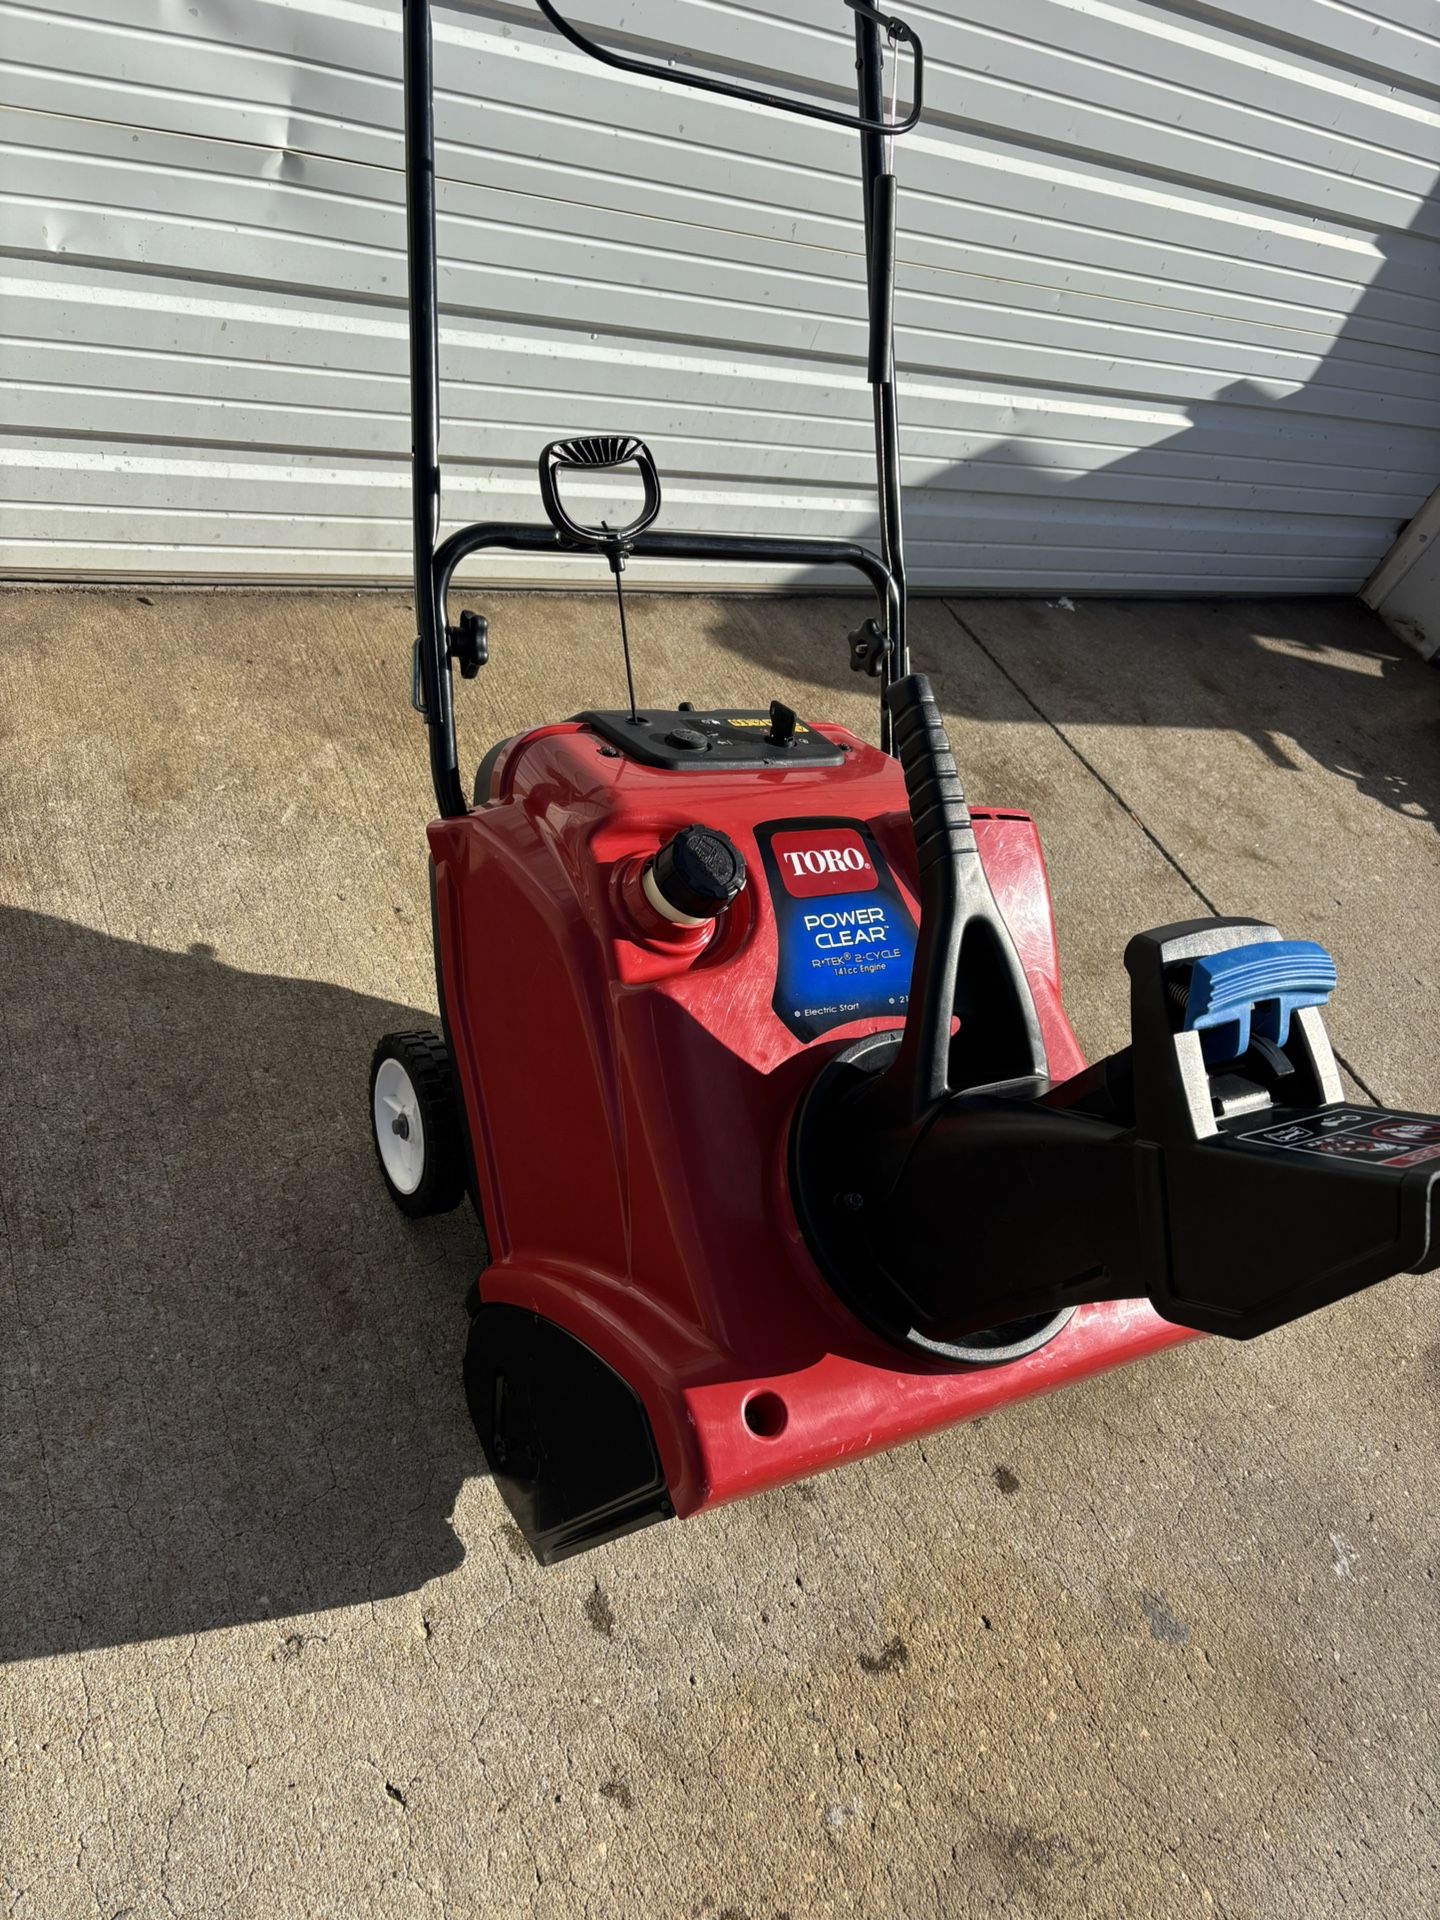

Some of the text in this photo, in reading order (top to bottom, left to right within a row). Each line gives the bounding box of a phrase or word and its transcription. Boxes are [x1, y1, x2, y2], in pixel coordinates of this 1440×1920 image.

[804, 907, 886, 931] POWER
[854, 948, 902, 963] 2-CYCLE
[834, 963, 886, 976] 141cc Engine
[804, 1002, 860, 1017] Electric Start
